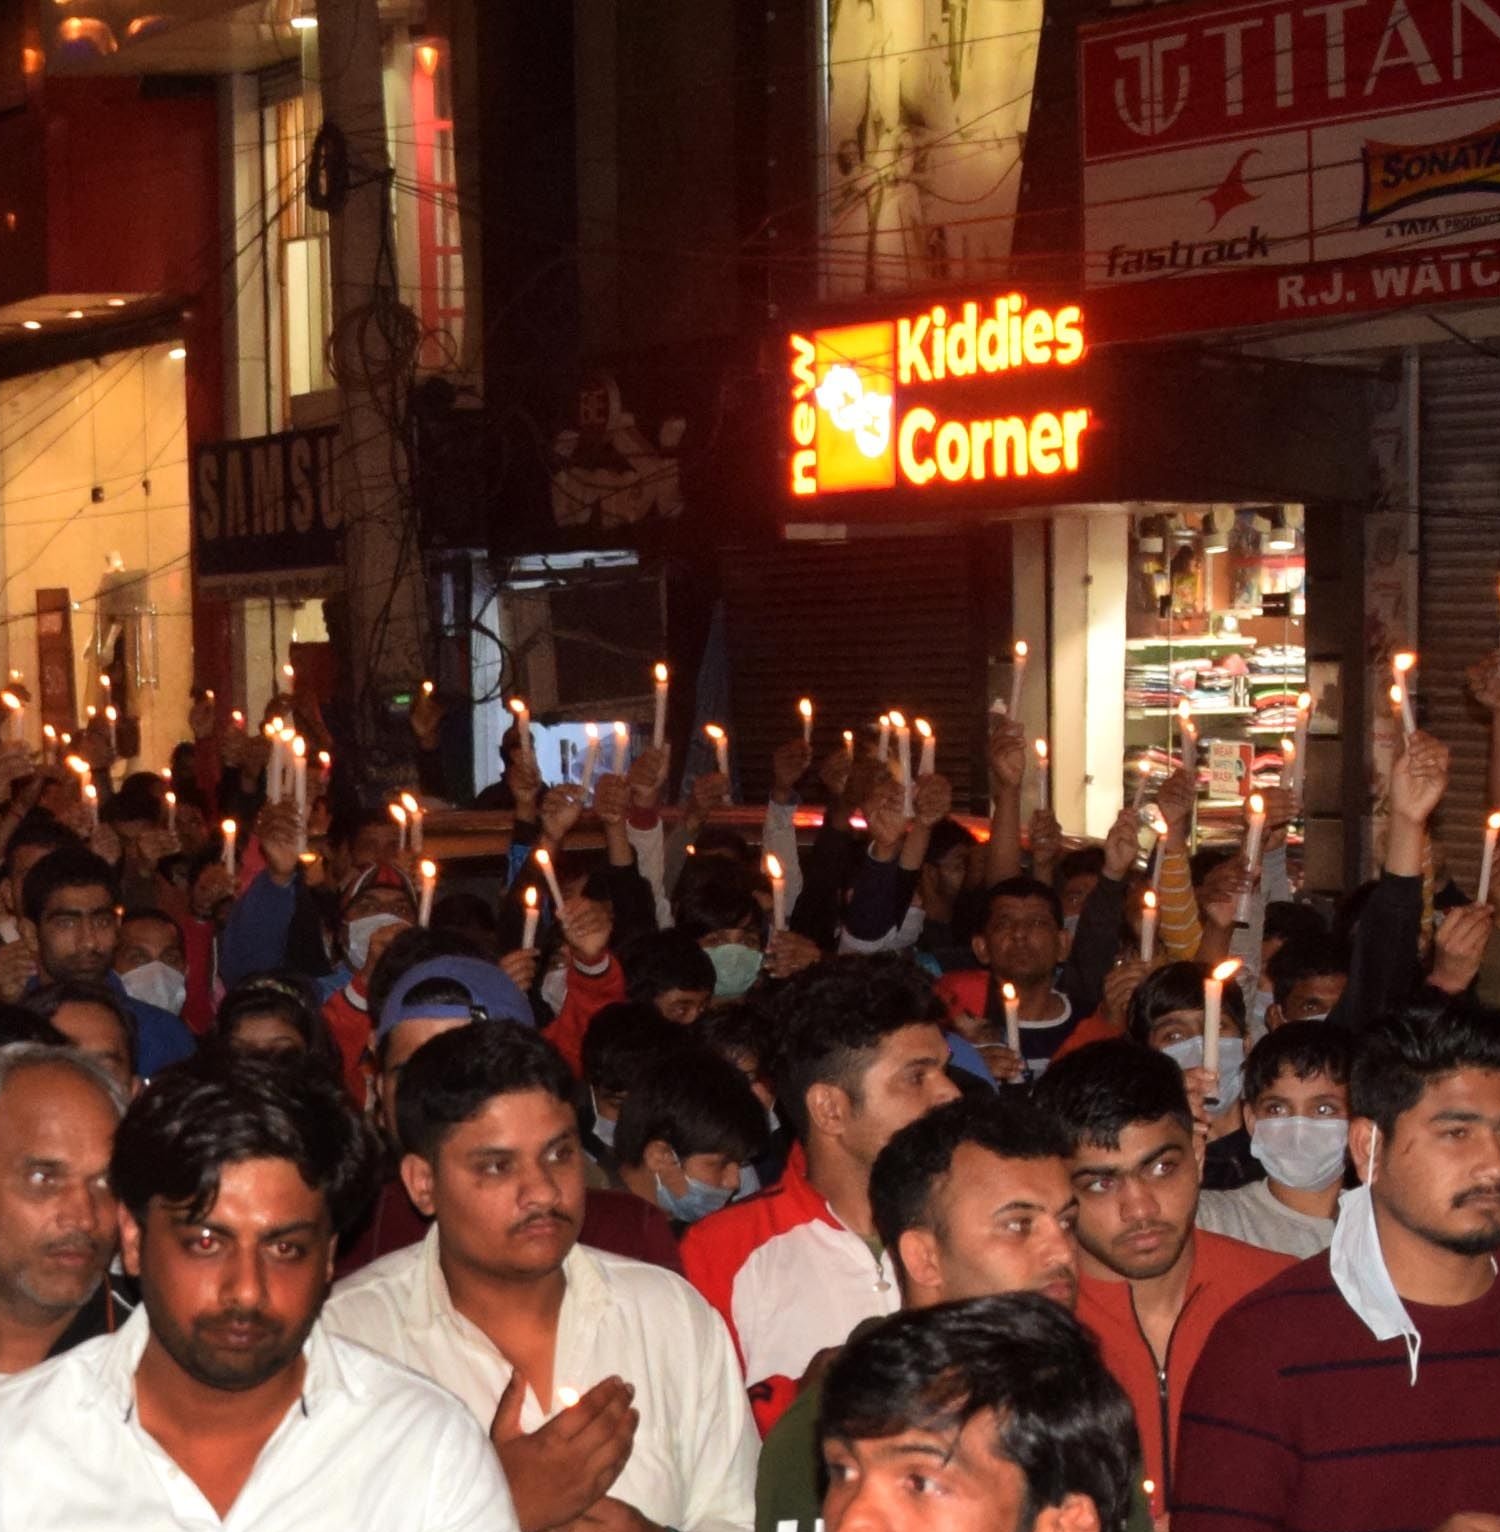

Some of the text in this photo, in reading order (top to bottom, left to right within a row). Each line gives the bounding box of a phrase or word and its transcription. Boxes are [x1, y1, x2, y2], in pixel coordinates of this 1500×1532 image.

[1106, 227, 1271, 278] fastrack
[1277, 272, 1357, 309] R.J.
[896, 293, 1084, 386] Kiddies
[789, 333, 818, 495] new
[897, 407, 1090, 486] Corner
[199, 433, 343, 540] SAMSU
